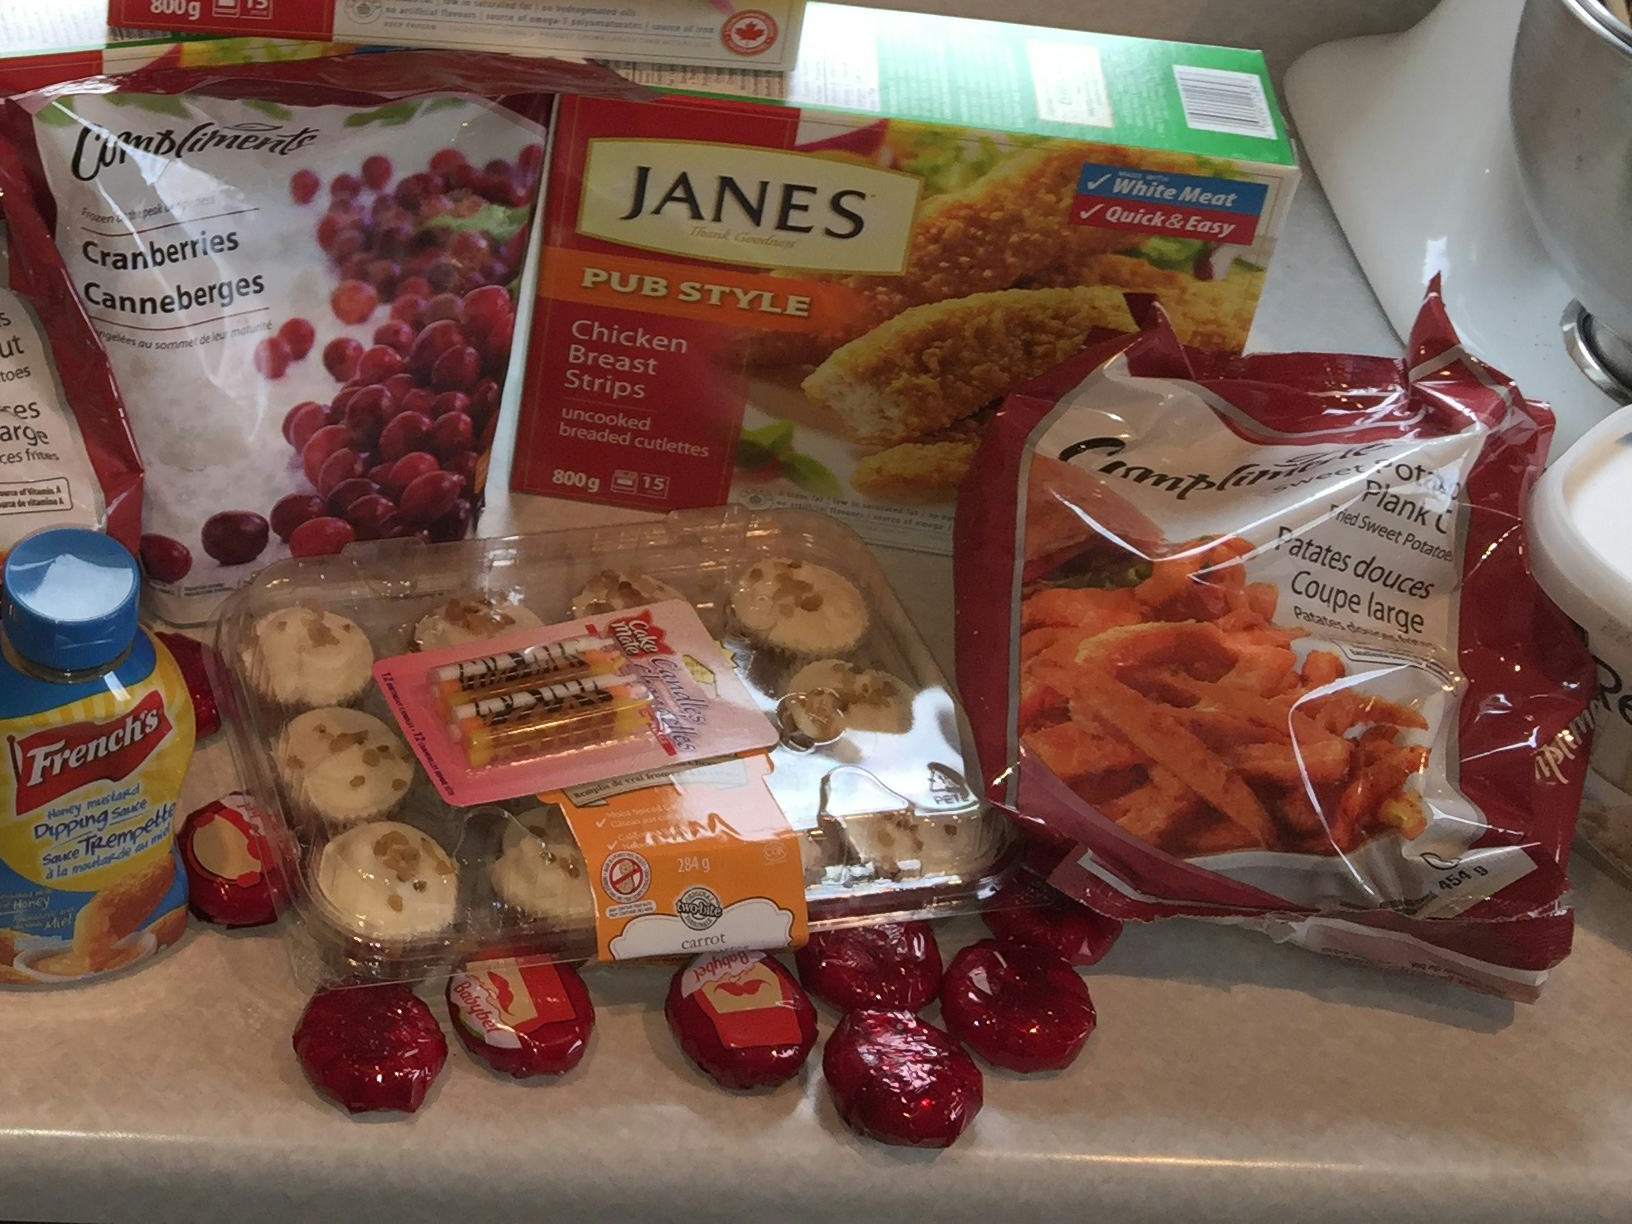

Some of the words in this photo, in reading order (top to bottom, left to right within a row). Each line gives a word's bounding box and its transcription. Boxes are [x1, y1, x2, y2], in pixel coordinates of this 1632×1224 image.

[70, 122, 321, 182] Compliments
[620, 165, 866, 239] JANES
[1112, 176, 1178, 201] White
[1178, 185, 1238, 208] Meat
[81, 206, 115, 225] Frozen
[82, 230, 240, 271] Cranberries
[689, 226, 732, 241] Thank
[734, 231, 798, 249] Goodness
[83, 273, 266, 314] Canneberges
[579, 267, 669, 298] PUB
[678, 281, 811, 317] STYLE
[99, 329, 137, 347] ngelées
[138, 339, 153, 350] au
[571, 319, 688, 354] Chicken
[568, 343, 659, 375] Breast
[564, 369, 646, 400] Strips
[561, 407, 652, 431] uncooked
[25, 447, 60, 463] frites
[558, 421, 632, 446] breaded
[634, 435, 710, 458] cutlettes
[27, 485, 55, 497] Vitamin
[55, 485, 63, 495] A
[641, 475, 666, 491] 15
[17, 499, 26, 508] de
[26, 498, 57, 507] vitamine
[58, 497, 65, 505] A
[1360, 477, 1431, 528] Plank
[1358, 514, 1402, 547] Sweet
[1275, 526, 1350, 572] Patates
[1352, 553, 1436, 601] douces
[1290, 569, 1362, 615] Coupe
[1366, 590, 1426, 635] large
[1293, 605, 1348, 634] Patates
[628, 619, 659, 655] Cake
[649, 656, 709, 726] Candles
[26, 708, 160, 788] French's
[47, 801, 82, 821] Honey
[86, 782, 141, 809] mustard
[34, 809, 109, 840] Dipping
[42, 846, 80, 867] Sauce
[45, 866, 55, 881] à
[54, 863, 69, 879] la
[71, 845, 133, 874] moutarde
[133, 839, 149, 855] au
[677, 856, 700, 873] 284
[701, 858, 712, 873] g
[1438, 868, 1473, 892] 454
[1472, 865, 1490, 878] g
[13, 895, 50, 912] Honey
[680, 932, 727, 951] carrot
[692, 950, 752, 984] Babybel
[451, 980, 500, 1035] Babybel
